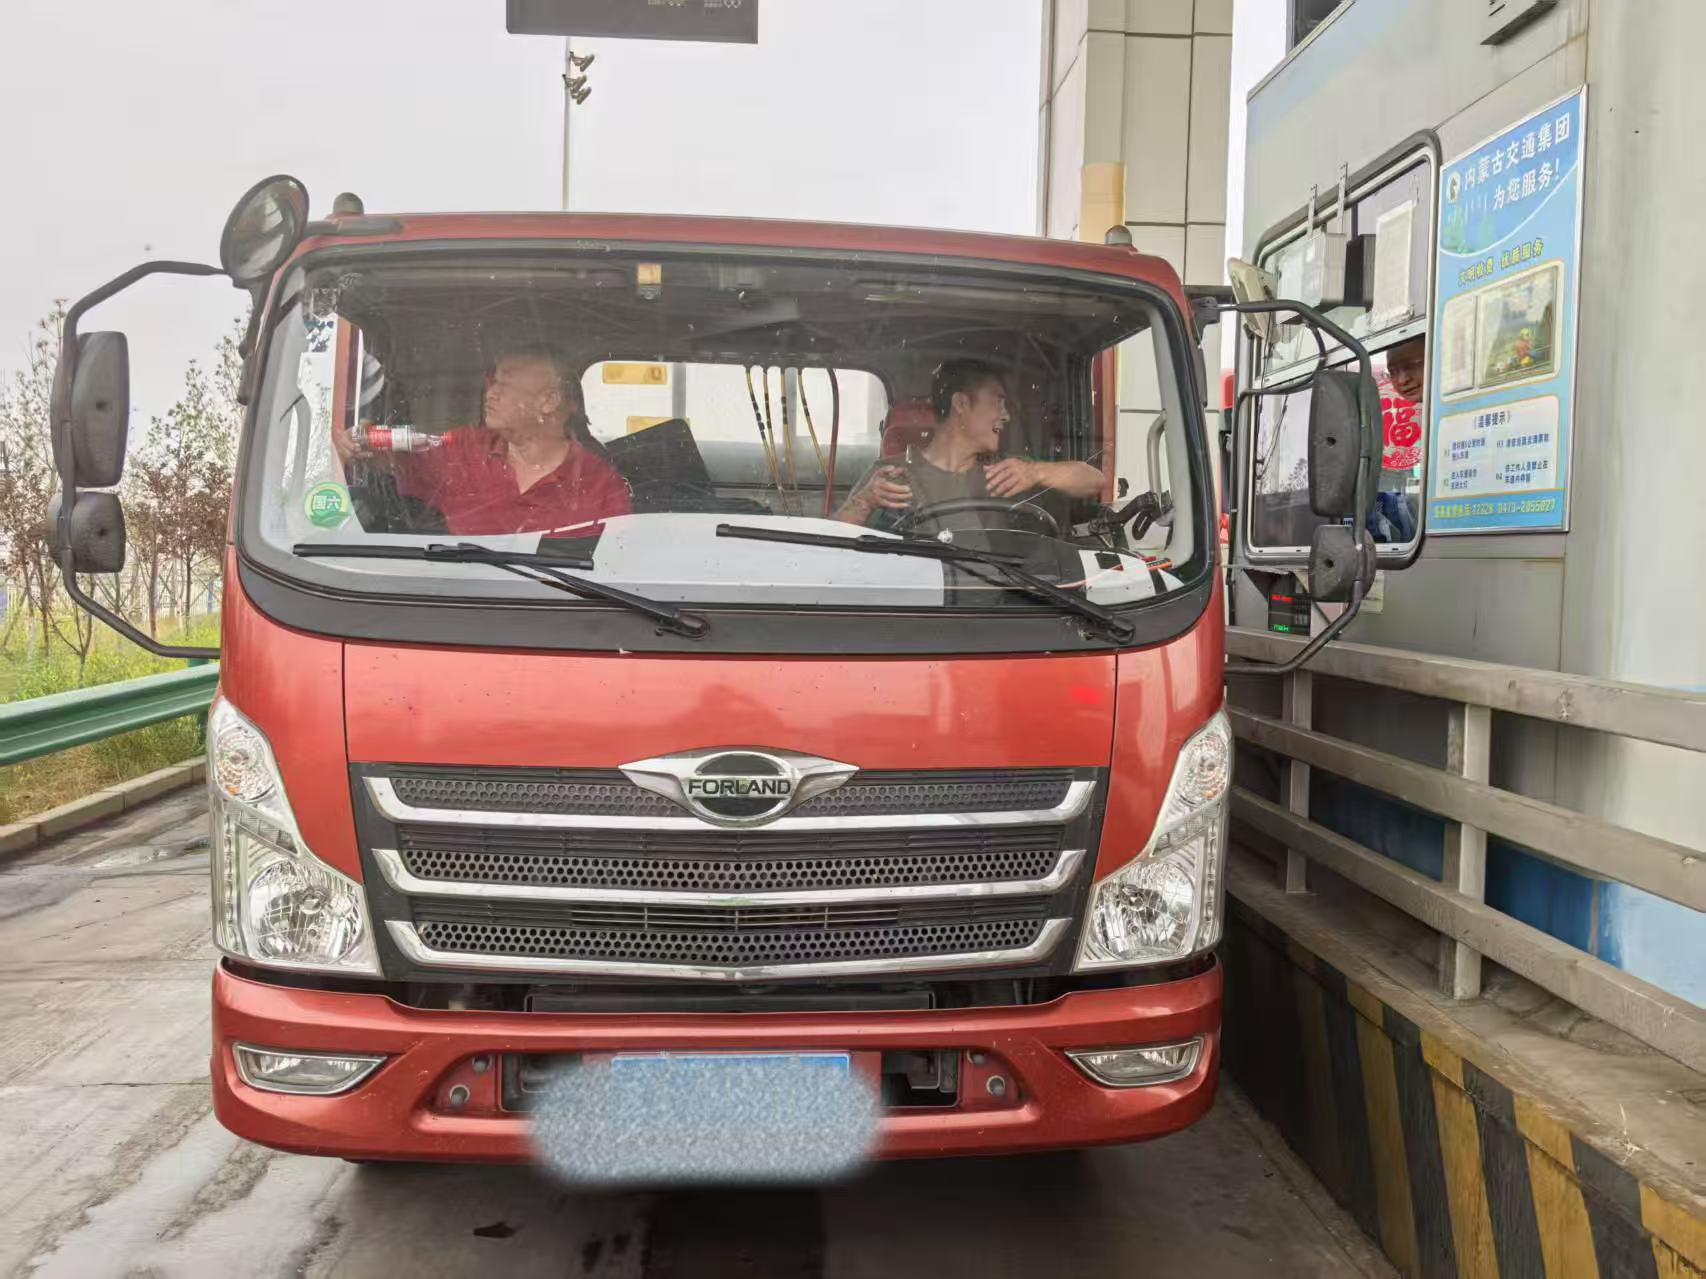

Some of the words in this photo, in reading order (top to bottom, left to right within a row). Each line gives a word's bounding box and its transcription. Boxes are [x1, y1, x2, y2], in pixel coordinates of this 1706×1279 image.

[1465, 112, 1570, 191] 内蒙古交通集团
[1380, 398, 1422, 447] 福
[312, 495, 341, 511] 国六
[688, 778, 792, 795] FORLAND
